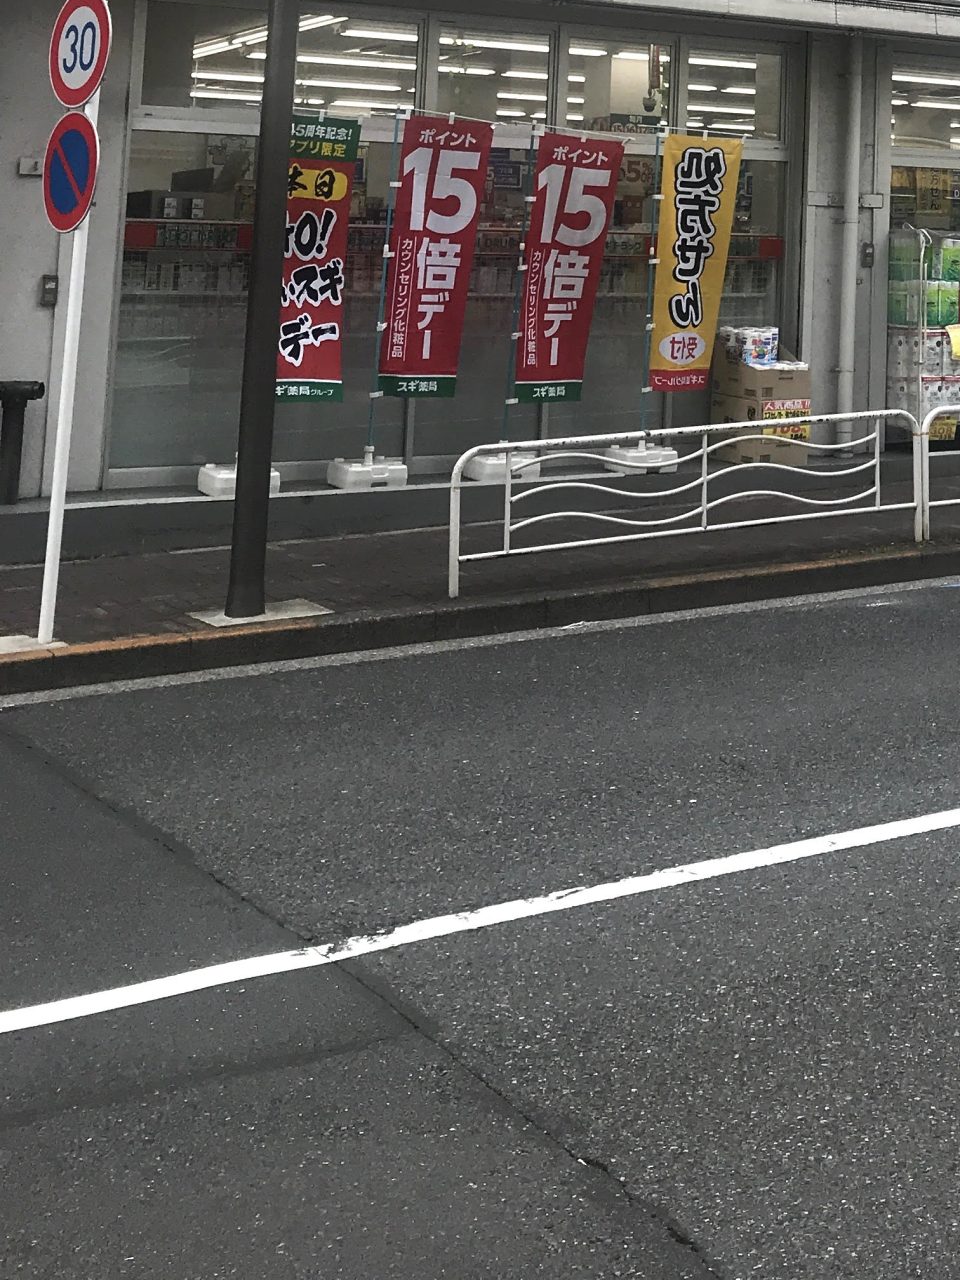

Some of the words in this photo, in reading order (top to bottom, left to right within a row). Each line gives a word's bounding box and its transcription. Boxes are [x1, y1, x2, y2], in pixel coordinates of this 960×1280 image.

[62, 21, 97, 74] 30
[419, 128, 477, 148] ポイント
[552, 146, 608, 166] ポイント
[403, 147, 481, 234] 15
[537, 164, 611, 247] 15
[391, 238, 413, 358] カウンセリング化粧品
[417, 237, 461, 360] 倍デー
[527, 250, 542, 365] カウンセリング化粧品
[543, 249, 590, 366] 倍デー
[397, 380, 438, 392] スギ薬局
[532, 386, 566, 398] スギ薬局
